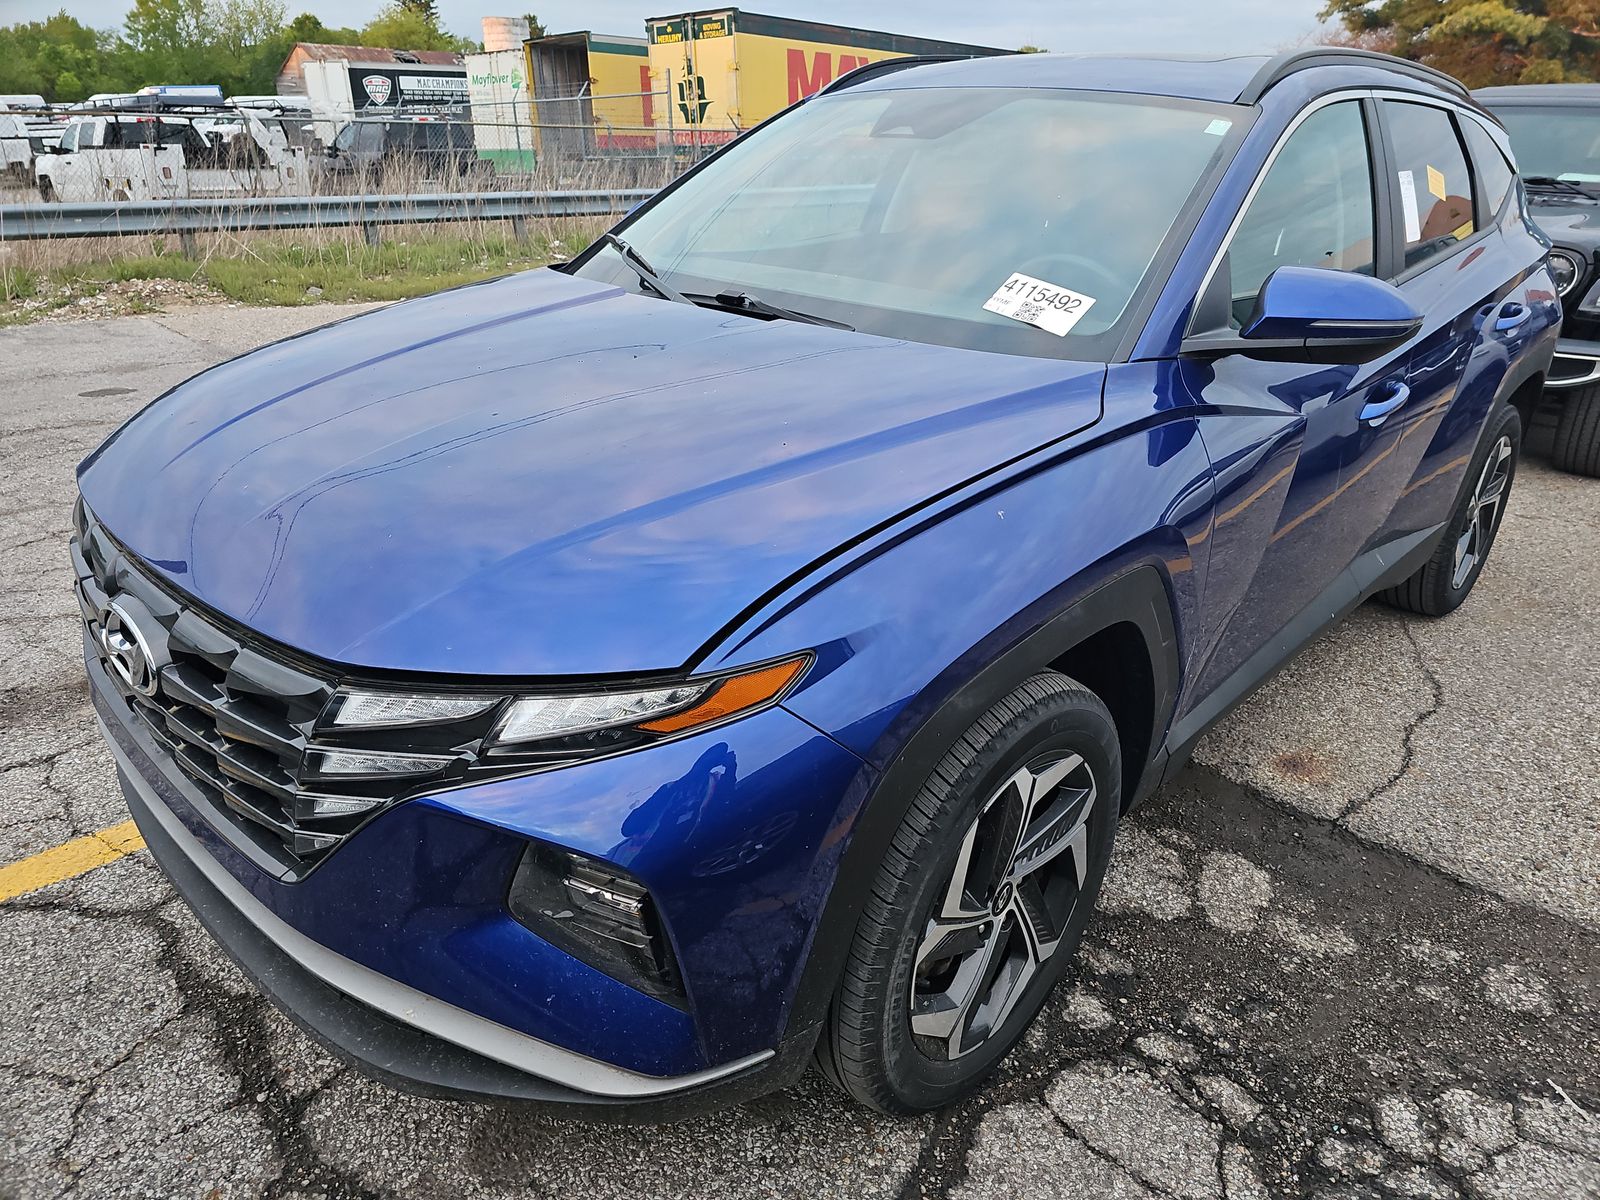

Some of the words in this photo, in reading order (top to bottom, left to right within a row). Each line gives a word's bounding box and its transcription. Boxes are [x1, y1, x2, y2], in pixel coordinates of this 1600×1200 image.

[416, 78, 431, 88] MAC
[432, 79, 469, 89] CHAMPIONS
[471, 73, 509, 87] Mayflower
[1004, 279, 1082, 313] 4115492
